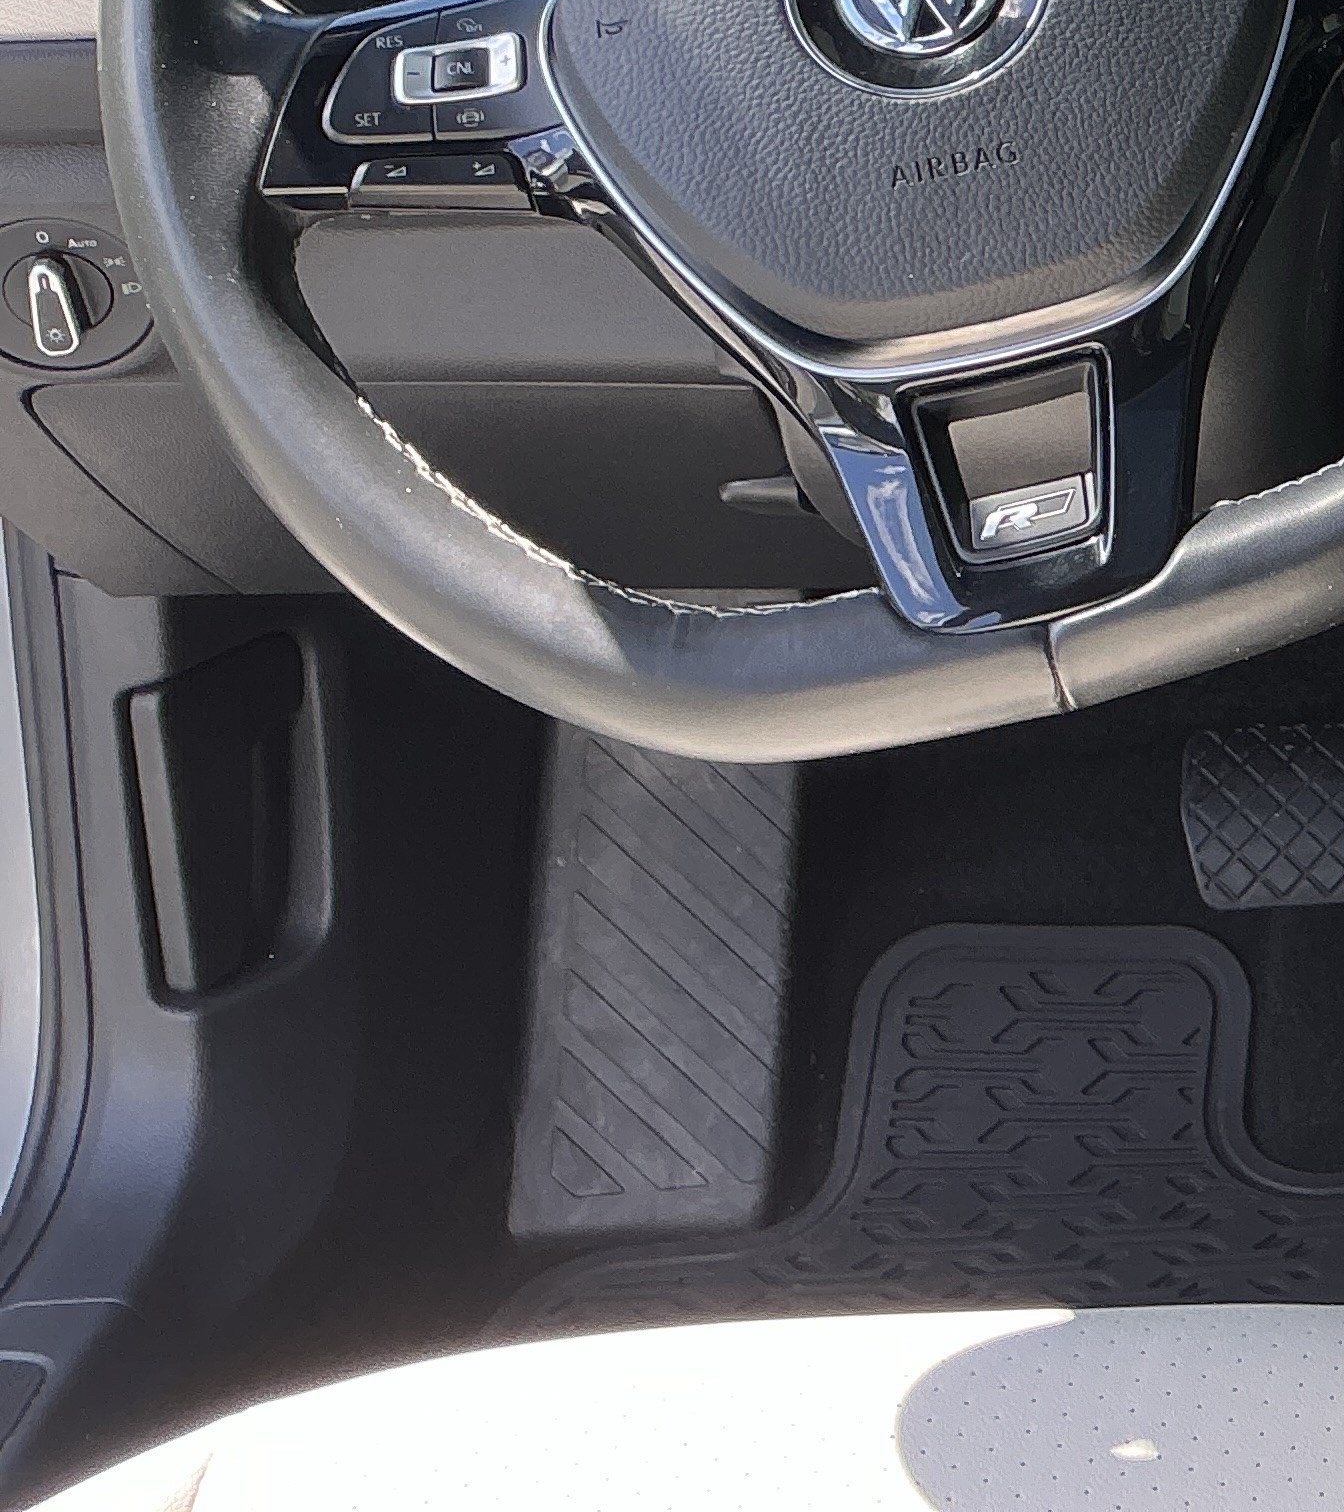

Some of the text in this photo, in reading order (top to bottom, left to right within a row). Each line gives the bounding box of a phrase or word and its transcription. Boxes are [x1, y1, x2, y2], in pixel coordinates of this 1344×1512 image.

[375, 36, 404, 50] RES
[446, 61, 475, 76] CNL
[354, 111, 382, 128] SET
[891, 140, 1020, 190] AIRBAG
